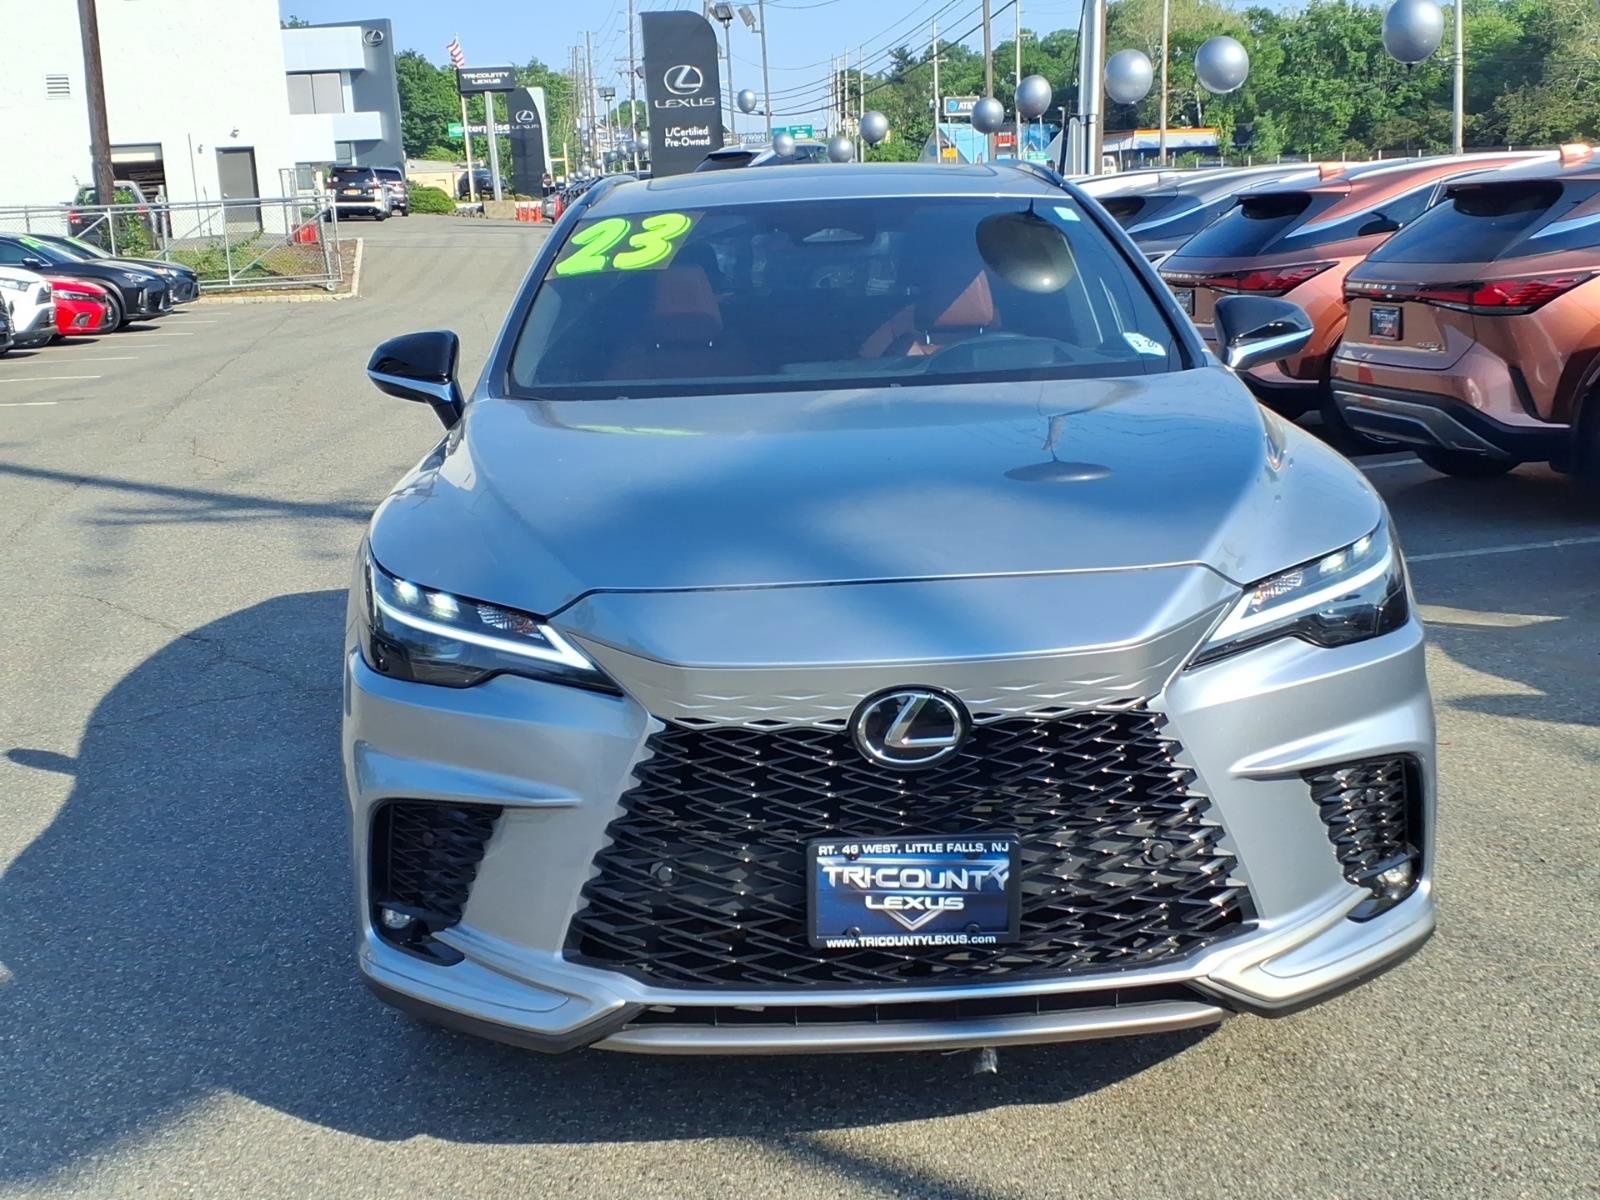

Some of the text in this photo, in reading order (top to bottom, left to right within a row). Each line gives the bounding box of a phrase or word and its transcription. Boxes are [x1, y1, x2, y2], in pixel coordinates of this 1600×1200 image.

[654, 97, 716, 109] LEXUS
[449, 122, 511, 134] enterise
[665, 136, 711, 148] Pre-Owned
[556, 212, 692, 277] 23
[818, 845, 838, 856] RT.
[862, 844, 901, 854] WEST,
[905, 843, 943, 853] LITTLE
[947, 843, 987, 853] FALLS,
[991, 842, 1009, 852] NJ
[865, 895, 965, 910] LEXUS
[826, 934, 996, 949] www.TRICOUNTYLEXUS.com
